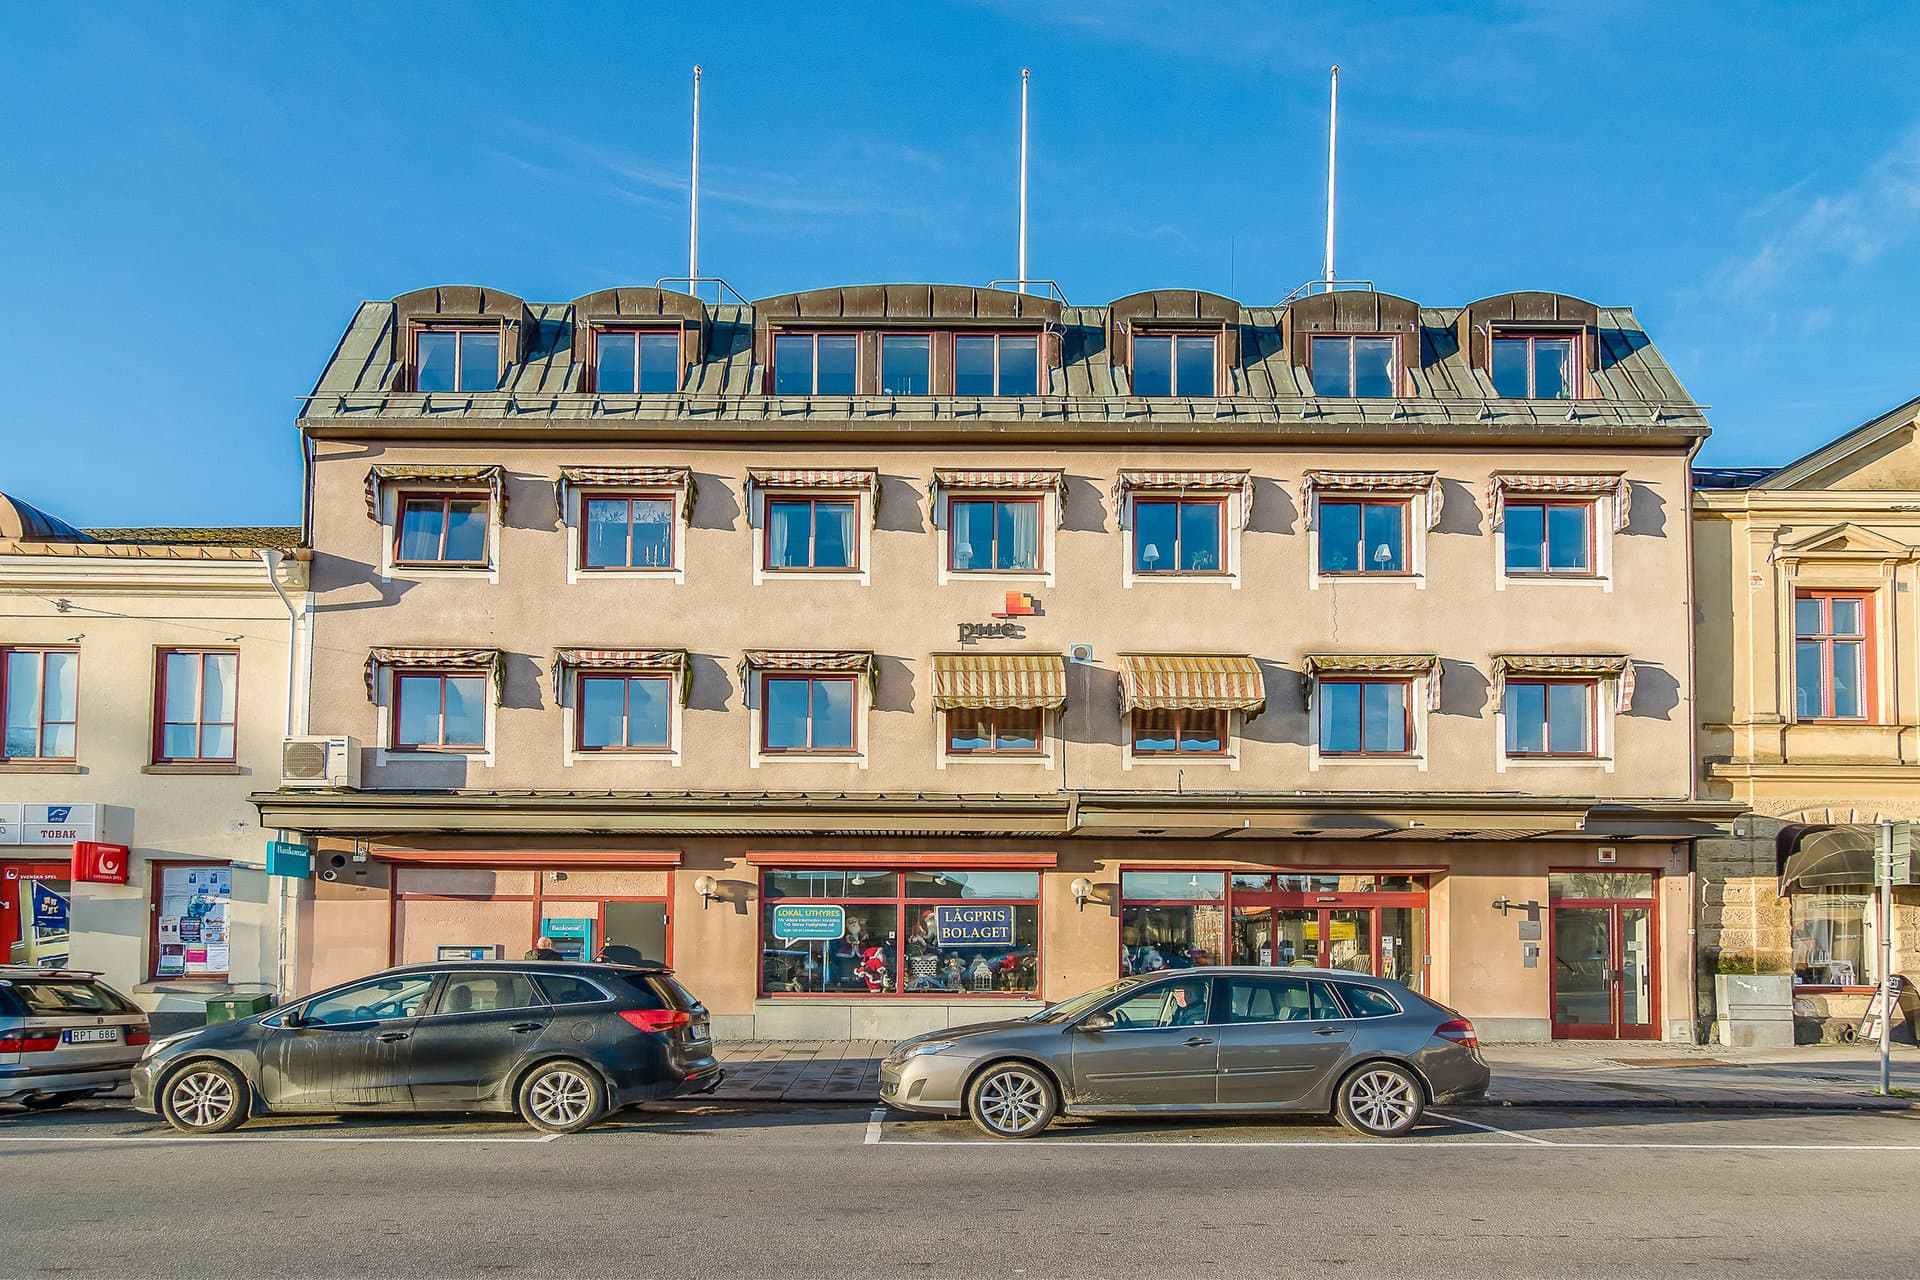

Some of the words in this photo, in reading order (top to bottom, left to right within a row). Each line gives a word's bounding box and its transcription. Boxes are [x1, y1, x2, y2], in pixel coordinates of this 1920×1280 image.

[40, 830, 77, 839] TOBAK
[778, 909, 803, 917] LOKAL
[805, 909, 840, 917] UTHYRES
[944, 908, 1006, 923] LÅGPRIS
[942, 927, 1009, 938] BOLAGET
[73, 1030, 93, 1040] RPT
[98, 1029, 116, 1039] 686
